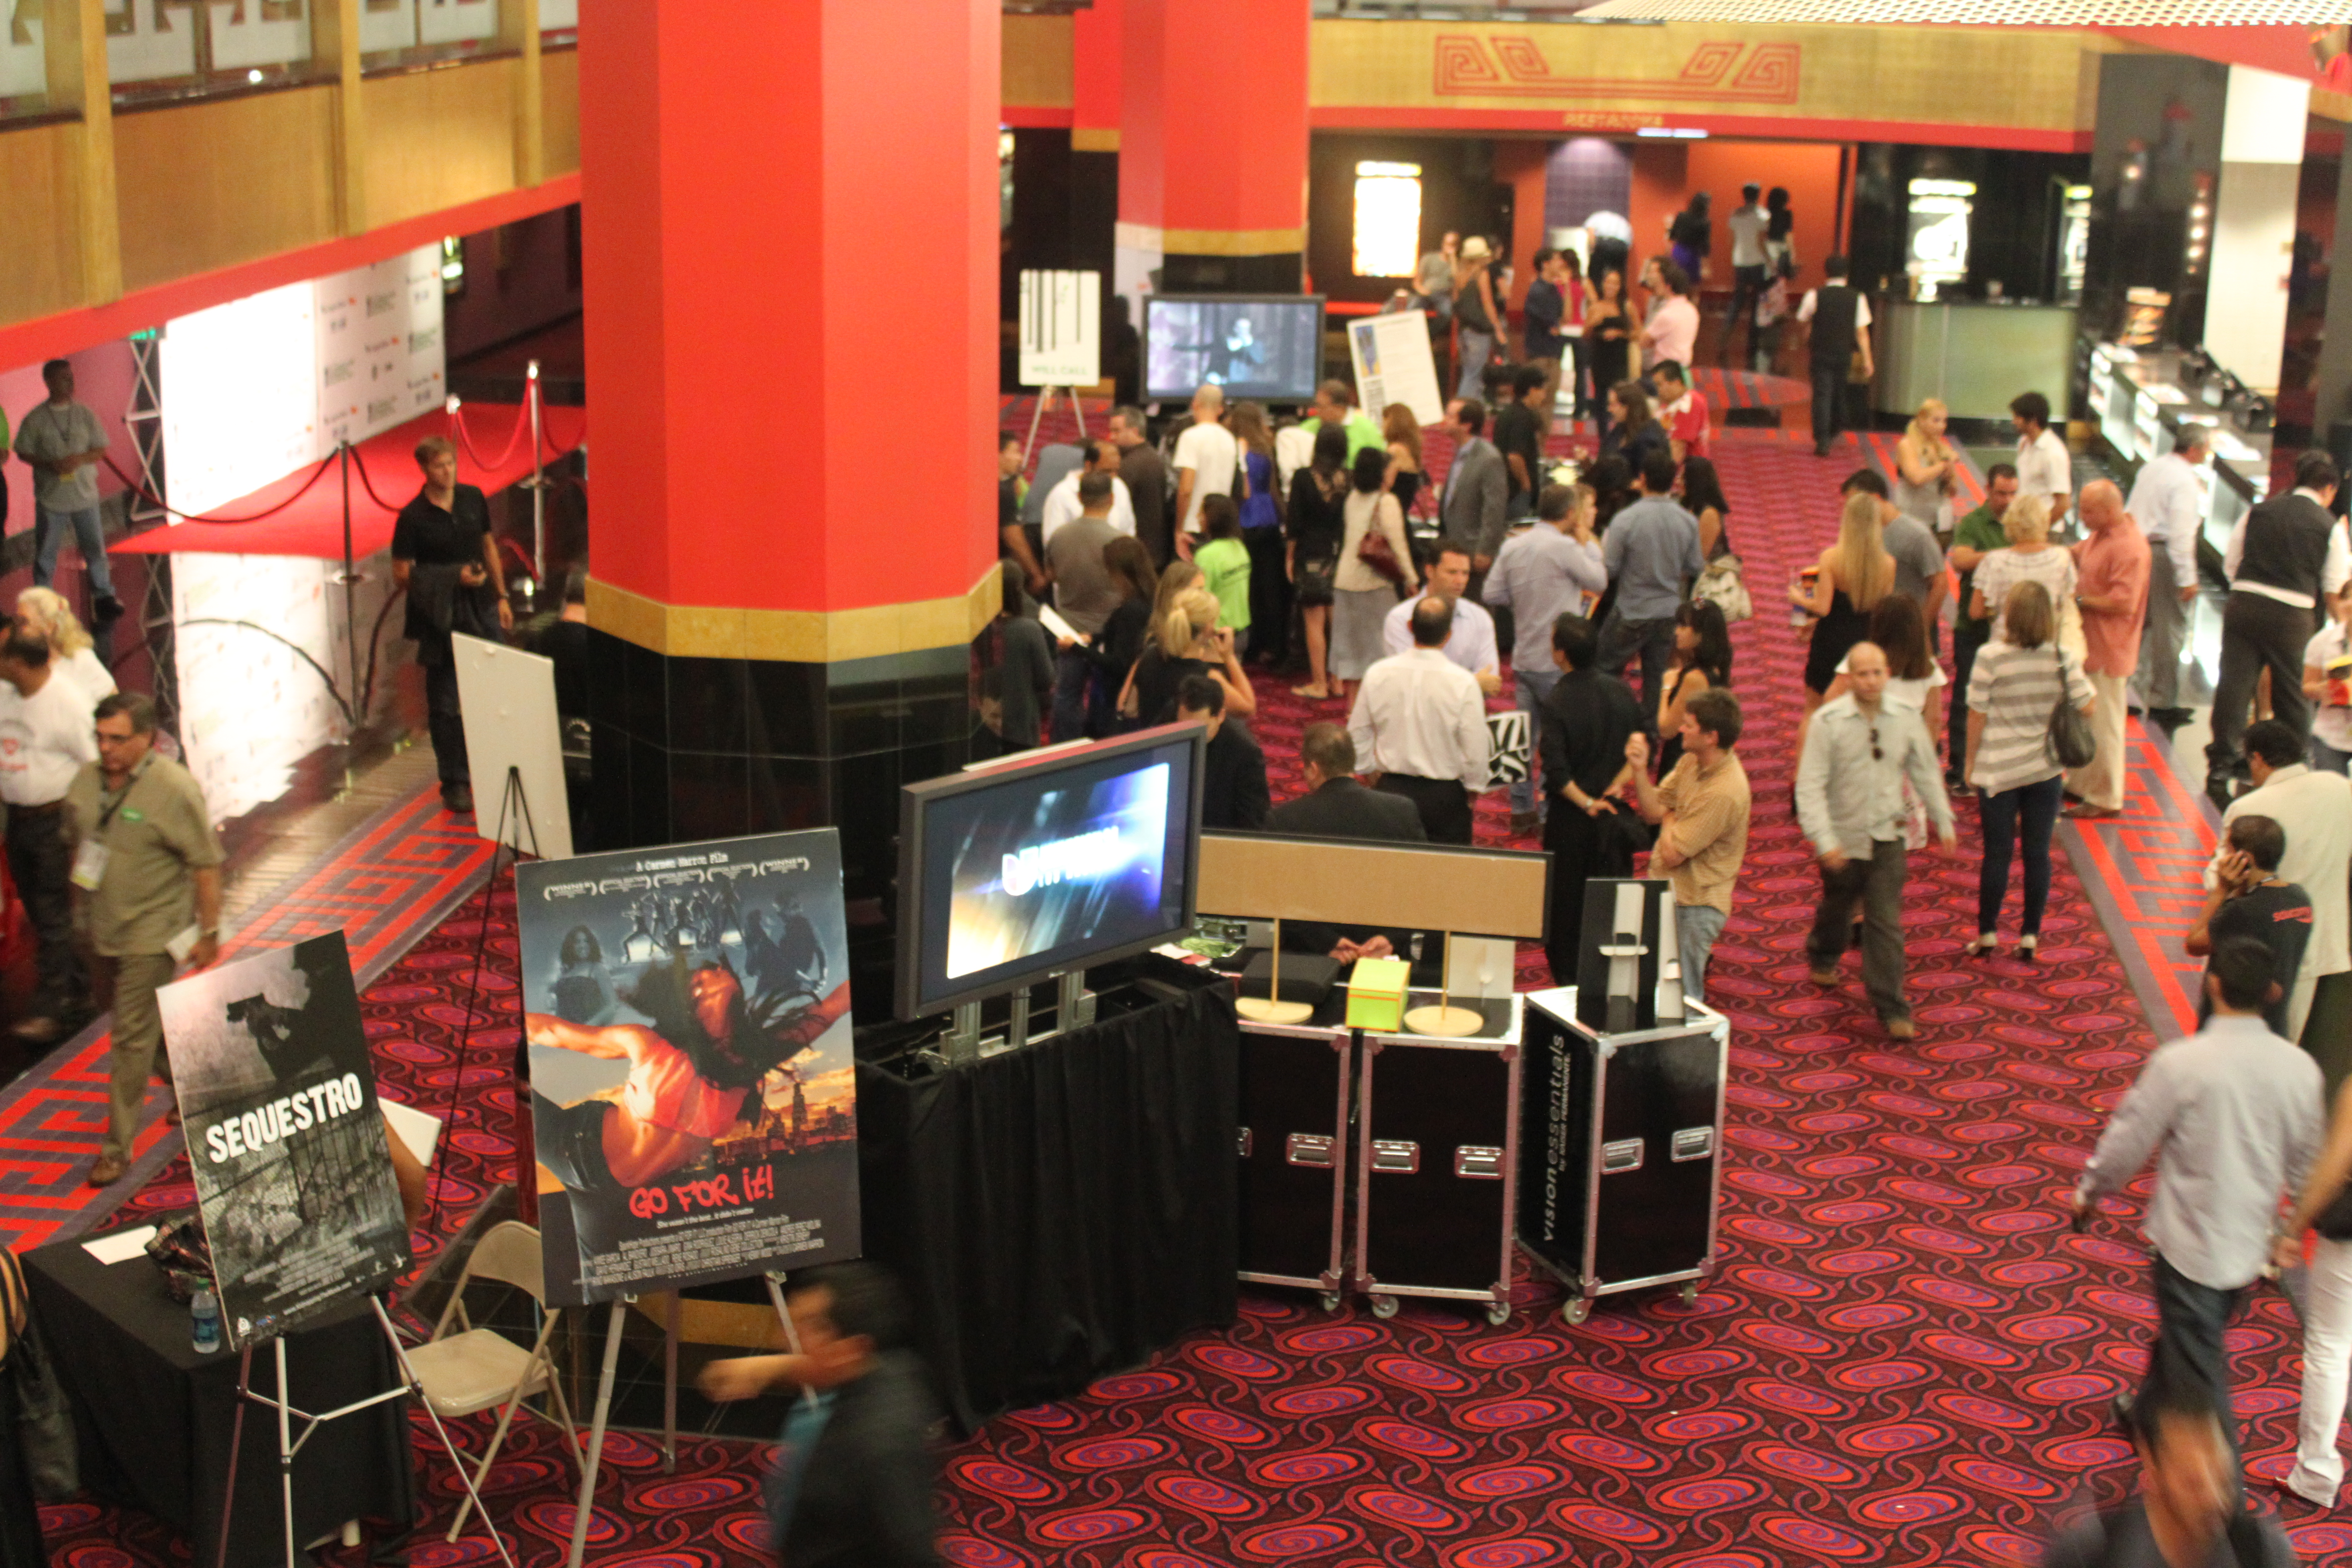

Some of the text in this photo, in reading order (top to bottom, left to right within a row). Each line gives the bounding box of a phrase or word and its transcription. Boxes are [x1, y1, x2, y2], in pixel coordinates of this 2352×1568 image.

[636, 860, 643, 872] A
[709, 851, 729, 864] Film
[765, 857, 804, 867] WINNER
[550, 882, 591, 891] WINNER
[206, 1073, 362, 1163] SEQUESTRO
[629, 1187, 668, 1219] GO
[672, 1174, 740, 1212] FOR
